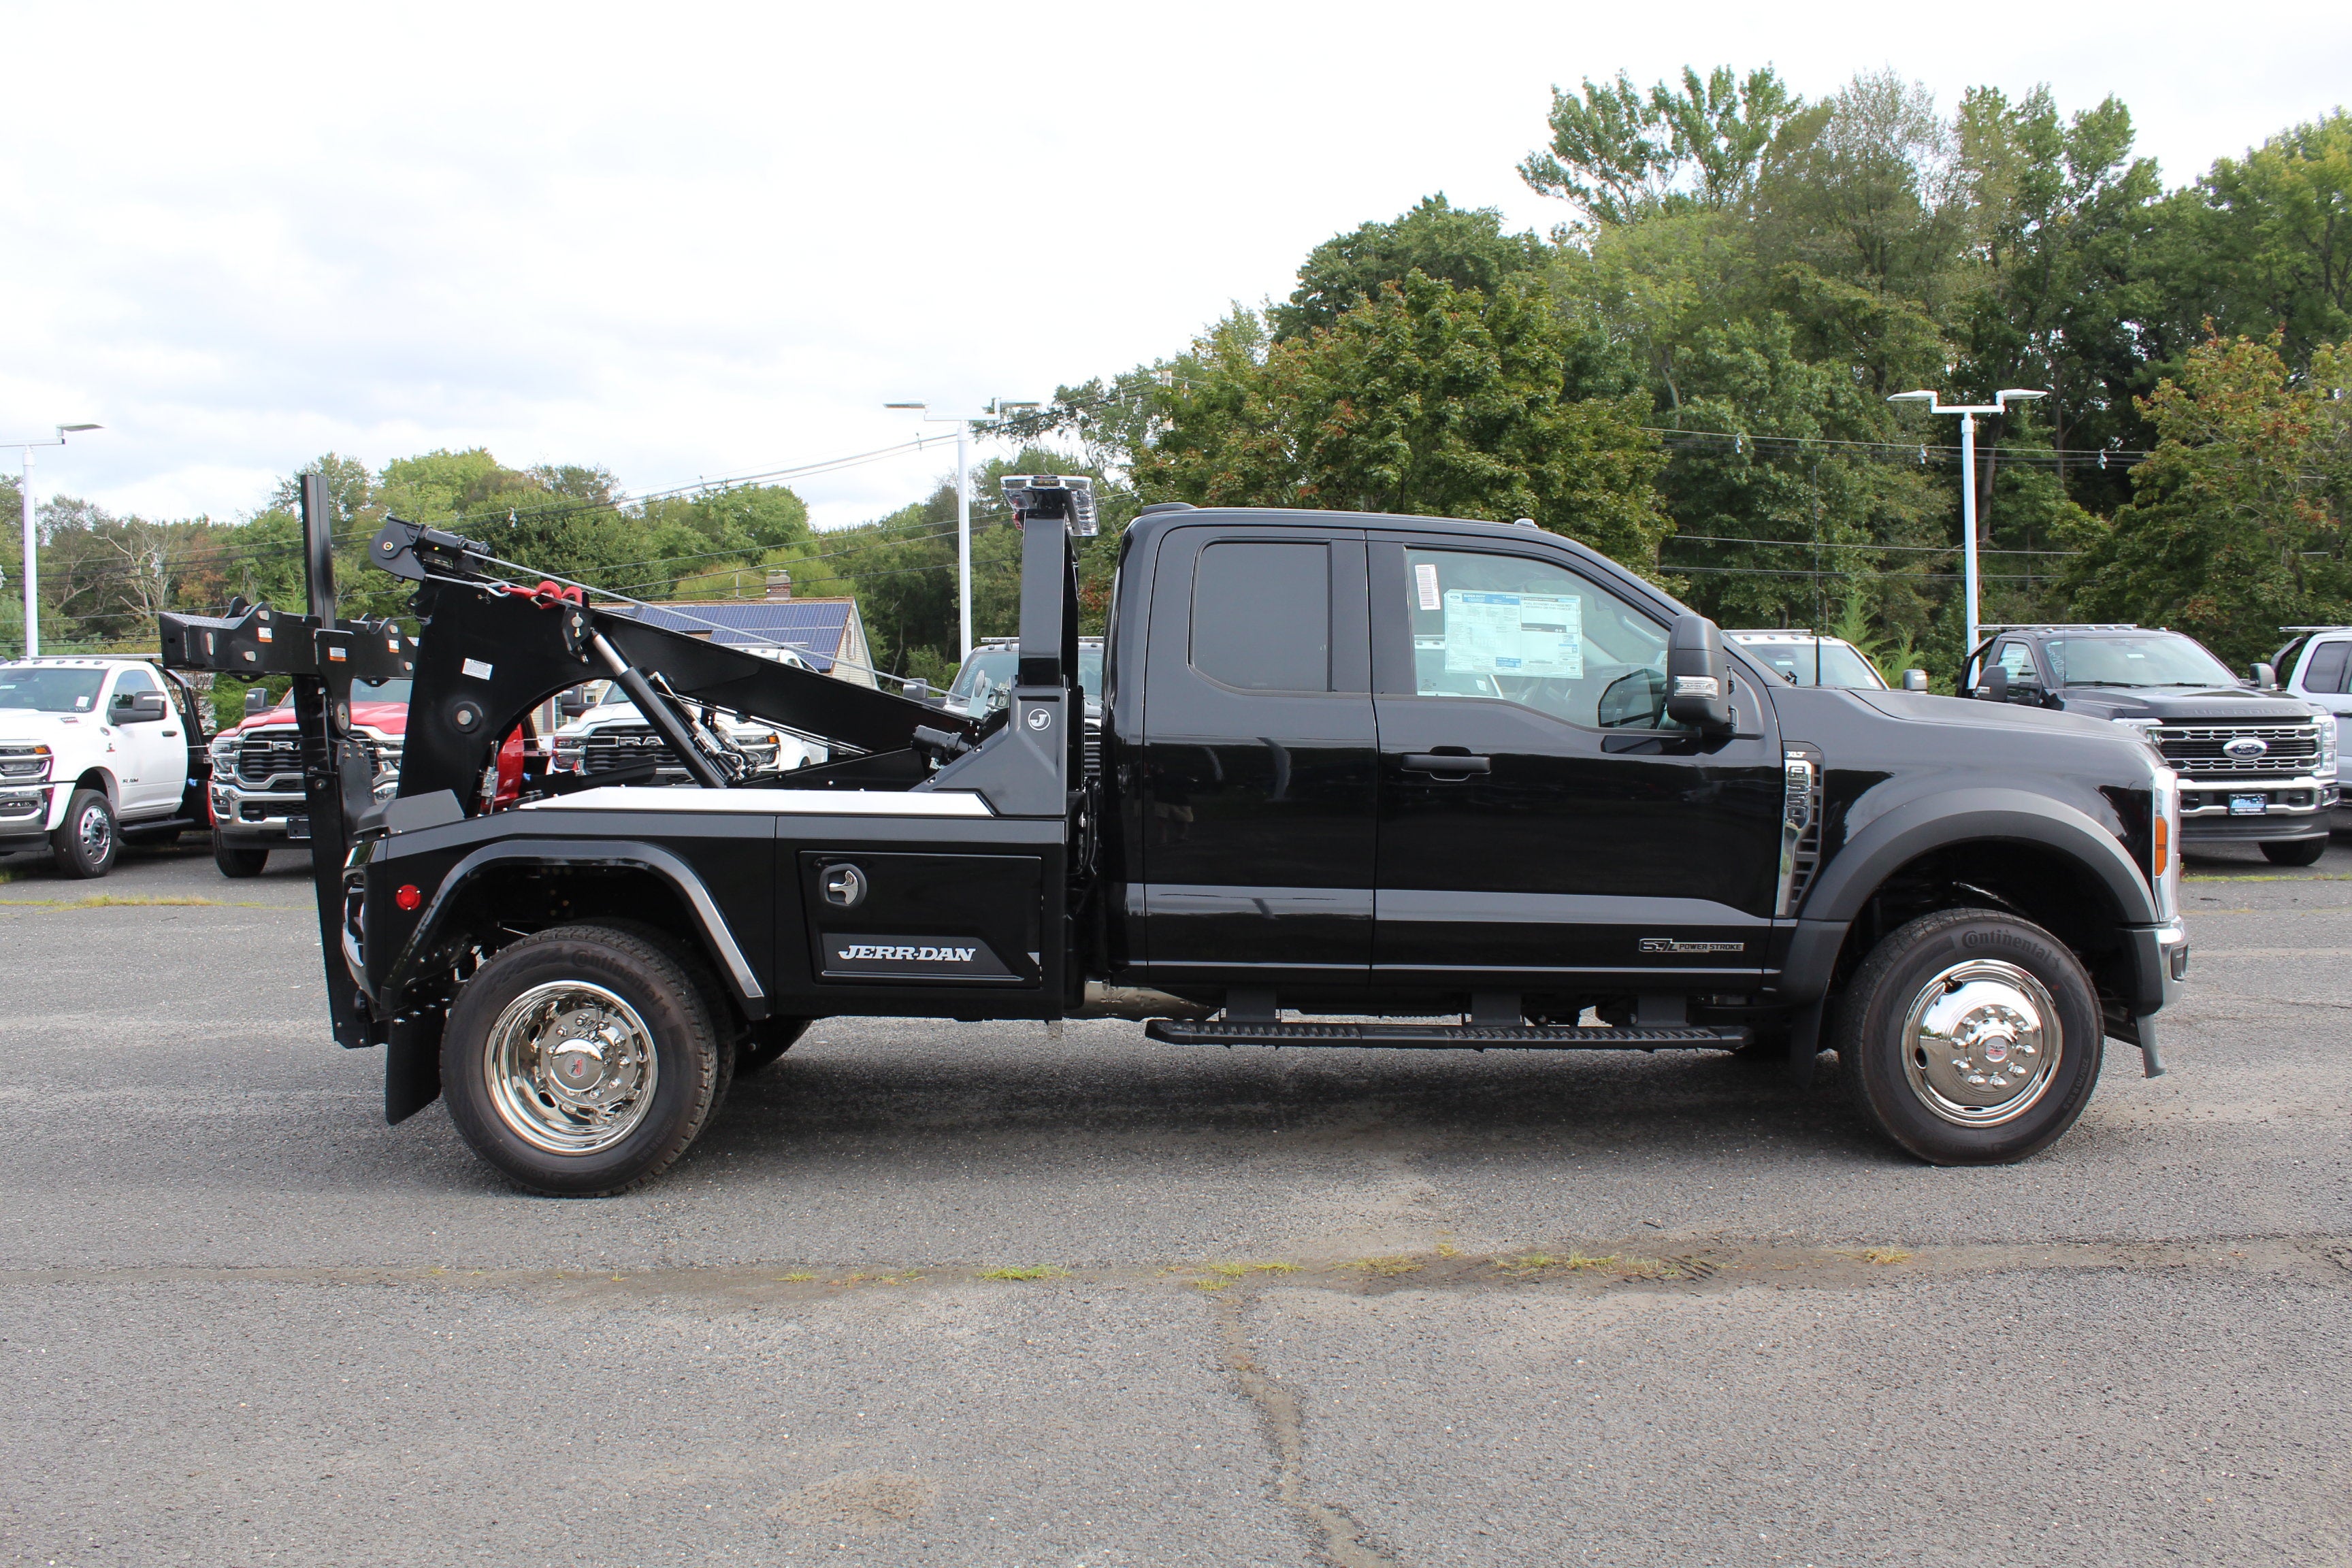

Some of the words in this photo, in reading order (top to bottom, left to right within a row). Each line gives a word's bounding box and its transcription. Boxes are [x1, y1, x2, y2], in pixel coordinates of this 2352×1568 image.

[619, 736, 666, 746] RA
[838, 944, 977, 962] JERR-DAN
[1961, 930, 2052, 962] Continental
